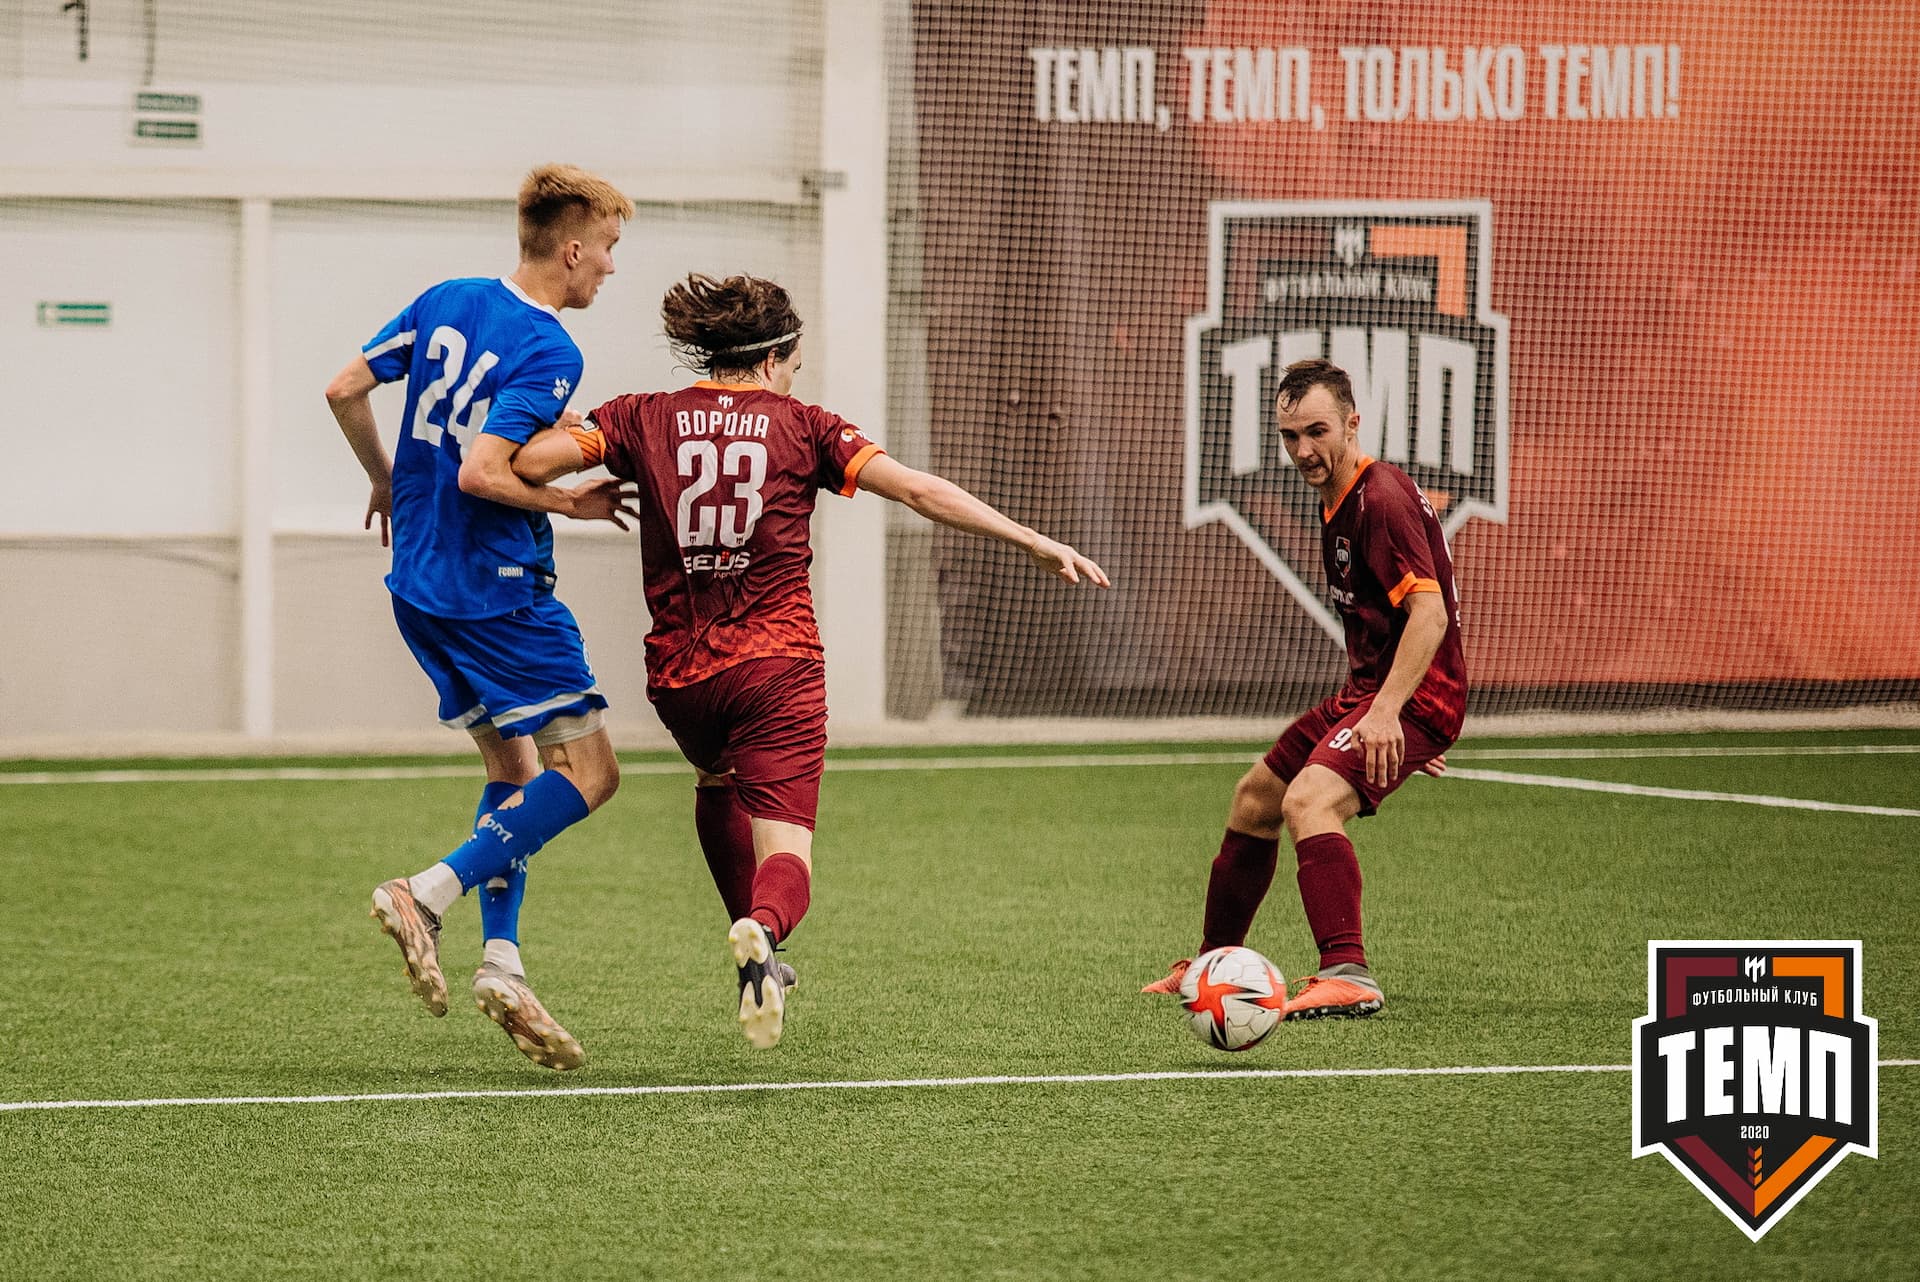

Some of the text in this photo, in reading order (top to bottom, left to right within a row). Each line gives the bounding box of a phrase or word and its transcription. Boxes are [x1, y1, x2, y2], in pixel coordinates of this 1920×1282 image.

[1031, 44, 1682, 132] ТЕМП, ТЕМП, ТОЛЬКО ТЕМП!
[412, 326, 500, 463] 24
[676, 410, 769, 438] ВОРОНА
[677, 440, 768, 548] 23
